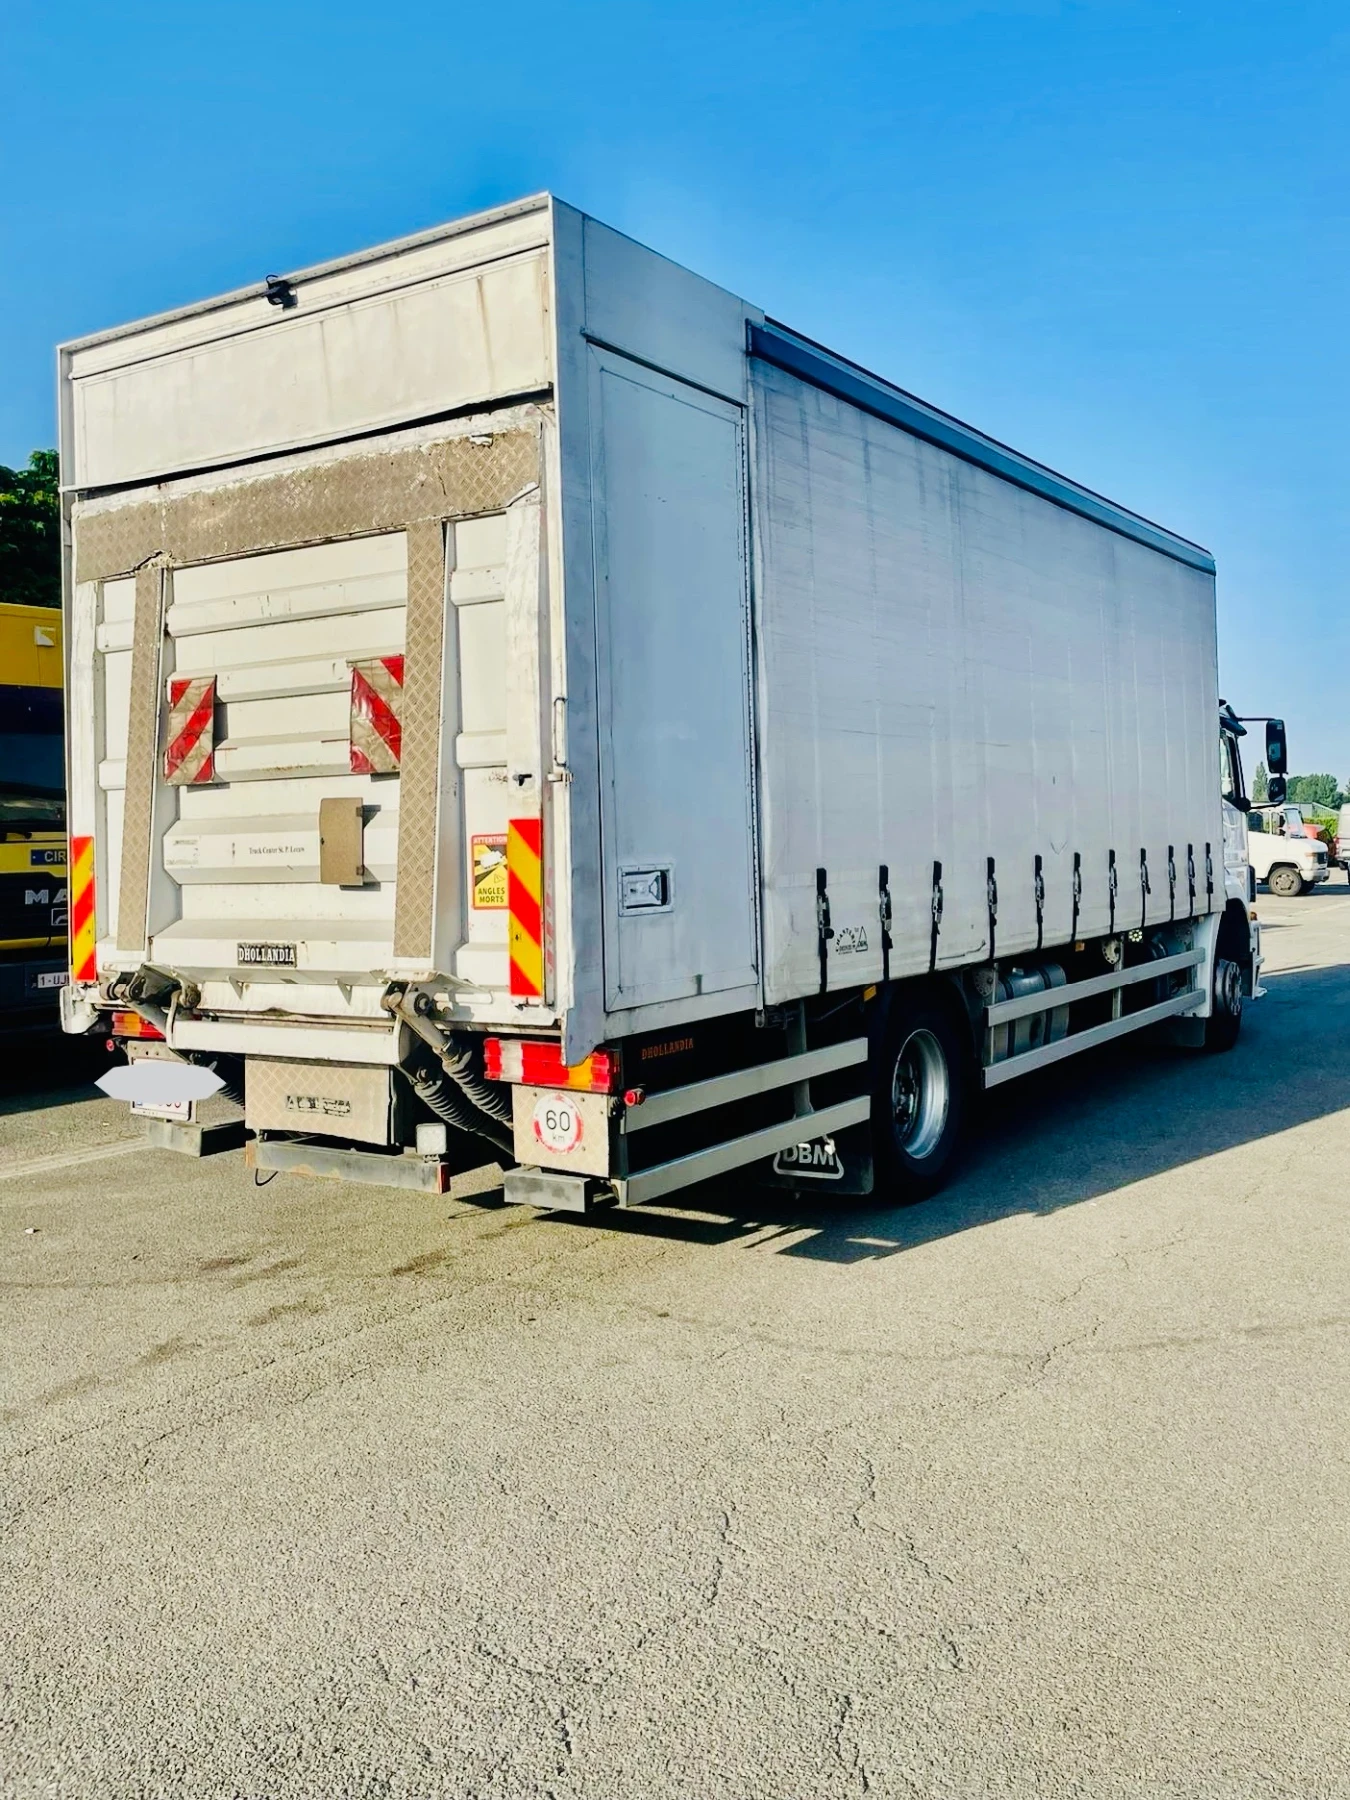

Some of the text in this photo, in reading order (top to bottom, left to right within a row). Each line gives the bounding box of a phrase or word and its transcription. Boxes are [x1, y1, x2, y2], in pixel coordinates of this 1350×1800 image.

[477, 886, 506, 895] ANGLES
[479, 895, 505, 904] MORTS
[238, 947, 295, 962] DHOLLANDIA
[641, 1038, 694, 1060] DHOLLANDIA
[546, 1109, 571, 1132] 60
[552, 1132, 565, 1143] km
[782, 1142, 835, 1166] DBM
